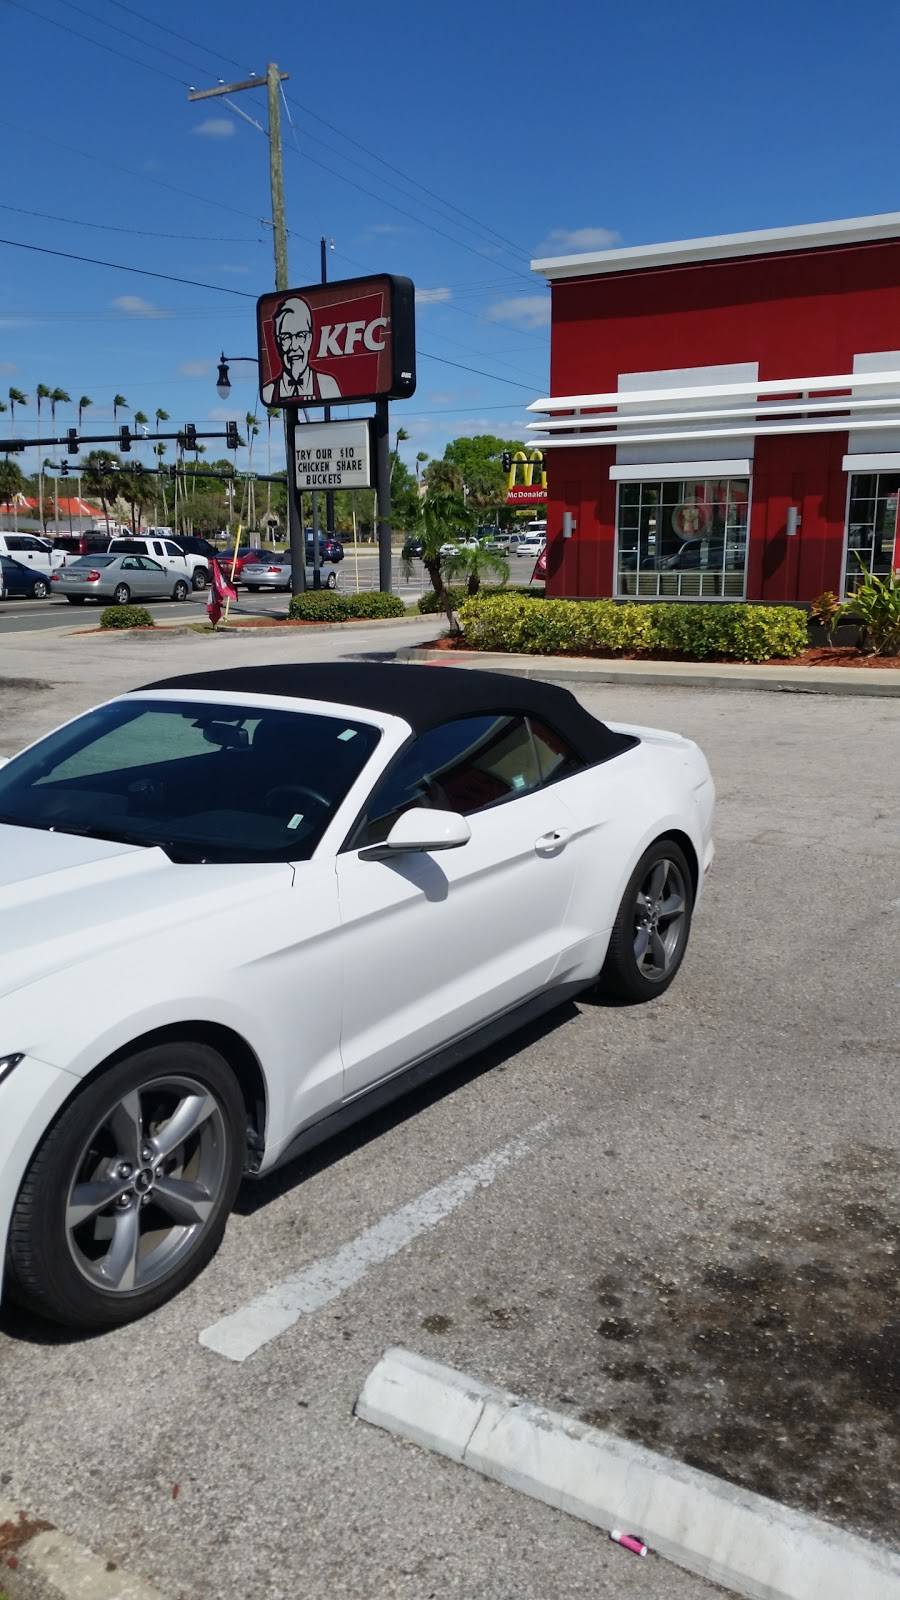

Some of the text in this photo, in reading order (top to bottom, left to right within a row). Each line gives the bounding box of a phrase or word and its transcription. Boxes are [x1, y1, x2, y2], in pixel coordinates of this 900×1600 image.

[316, 317, 388, 358] KFC
[296, 447, 354, 460] TRY OUR $10
[298, 460, 362, 472] CHICKEN SHARE
[306, 474, 342, 485] BUCKETS
